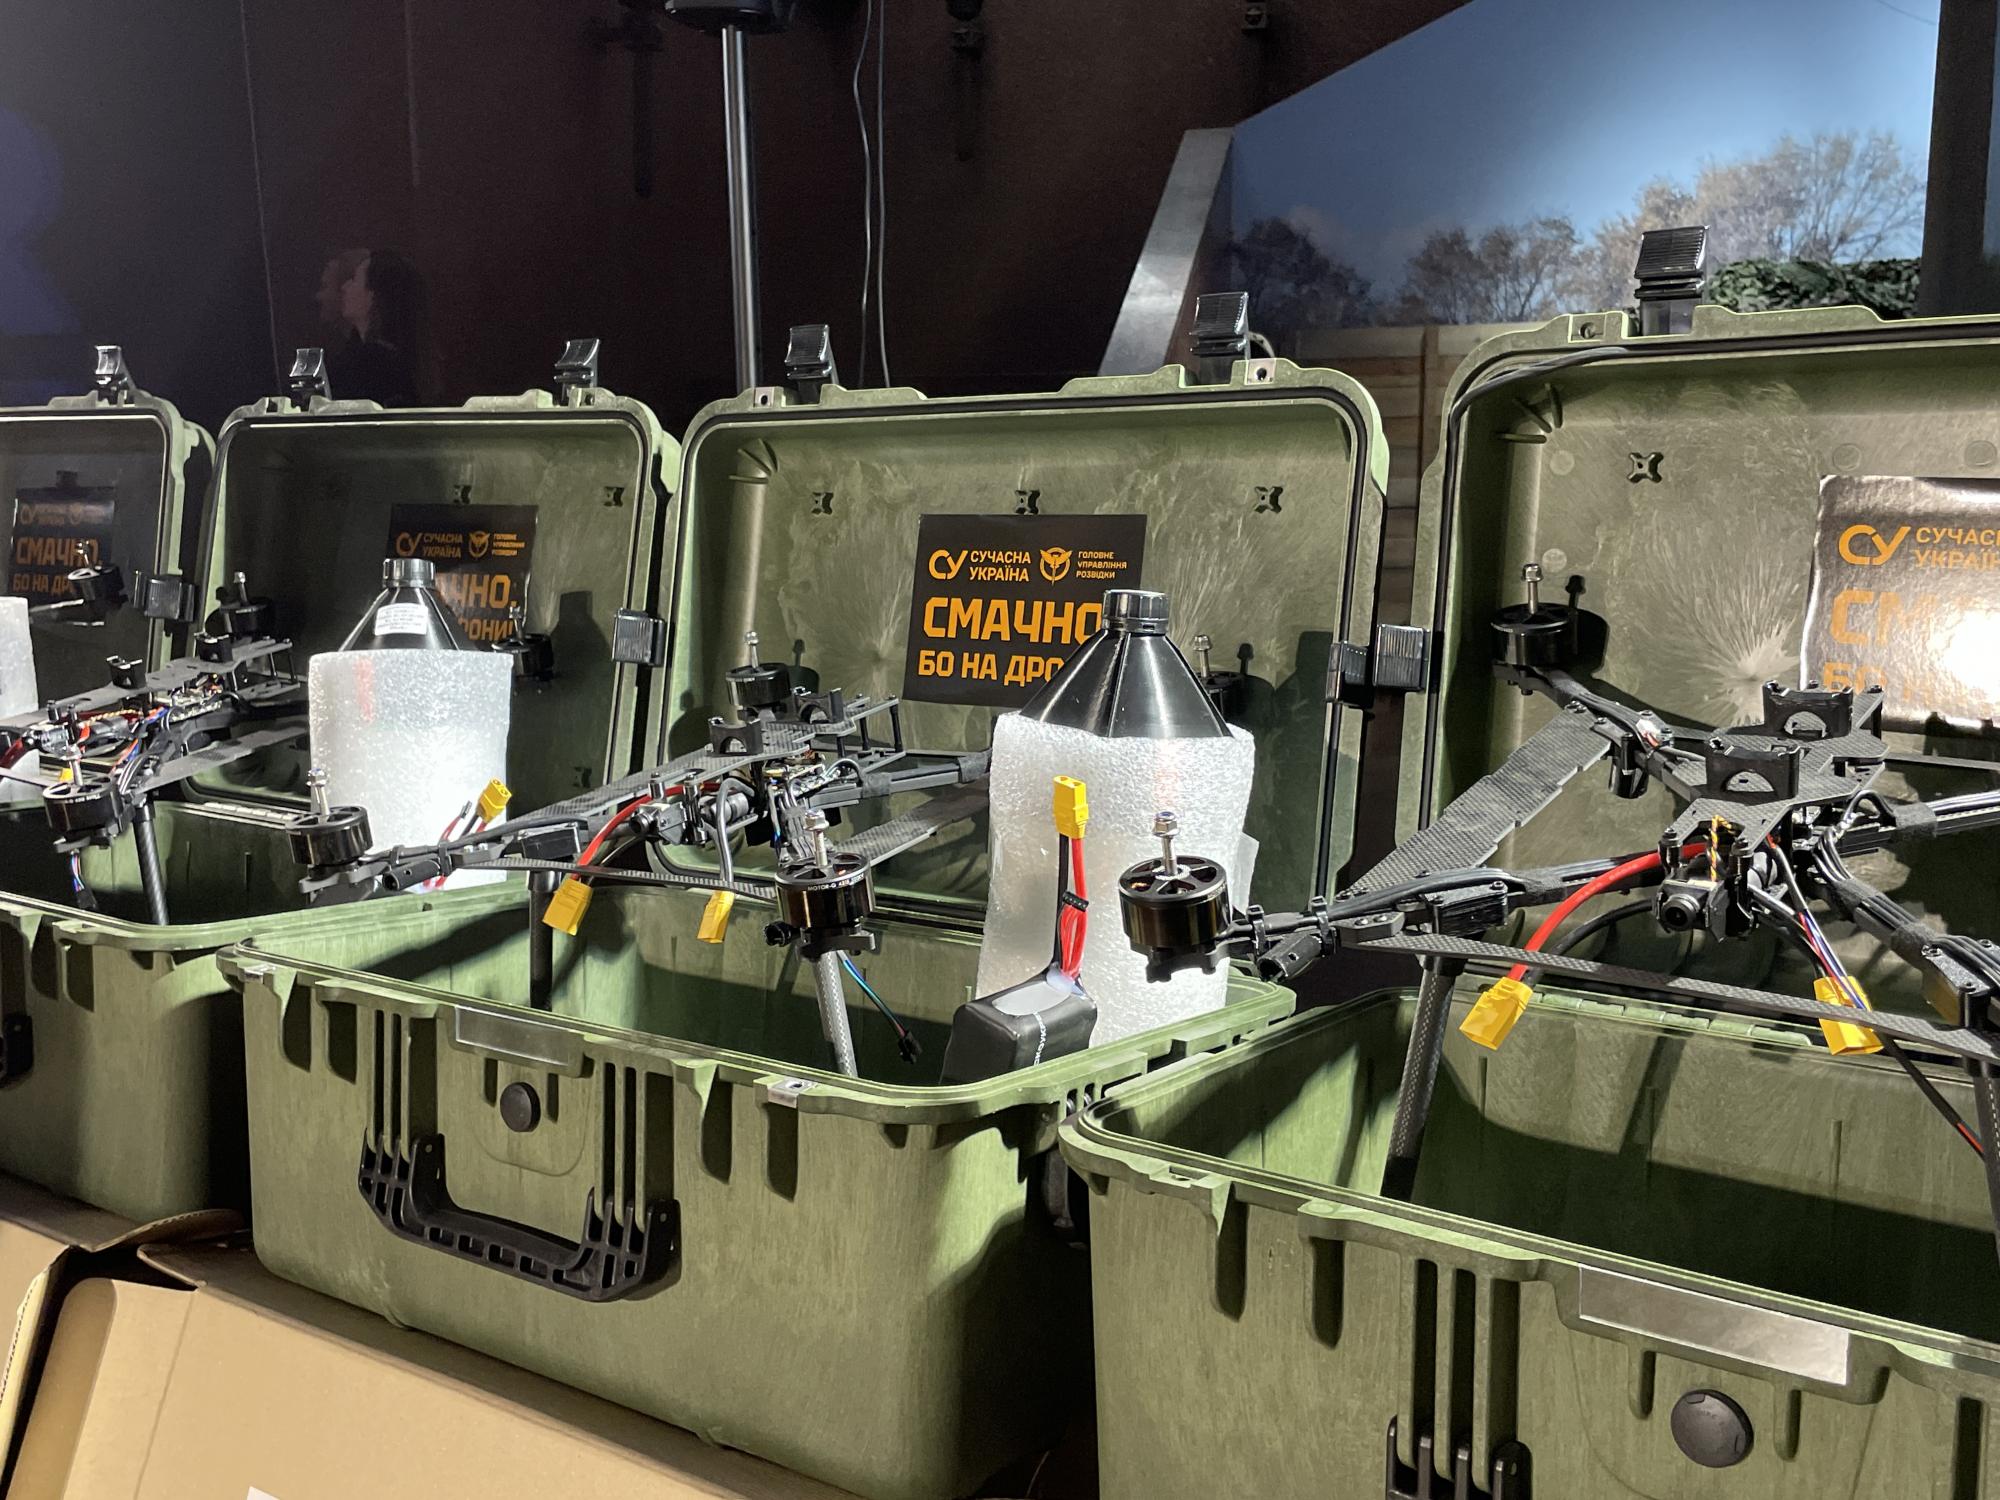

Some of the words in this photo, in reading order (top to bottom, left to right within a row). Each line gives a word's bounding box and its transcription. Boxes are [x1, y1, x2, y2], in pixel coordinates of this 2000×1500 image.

[396, 531, 423, 557] СУ
[1838, 524, 1911, 566] СУ
[1916, 527, 2000, 546] СУЧАС
[928, 549, 969, 580] СУ
[970, 550, 1031, 564] СУЧАСНА
[1077, 560, 1128, 569] УПРАВЛІННЯ
[1078, 551, 1115, 560] ГОЛОВНЕ
[969, 565, 1030, 582] УКРАЇНА
[1075, 570, 1116, 580] РОЗВІДКИ
[918, 649, 955, 677] БО
[961, 652, 998, 681] НА
